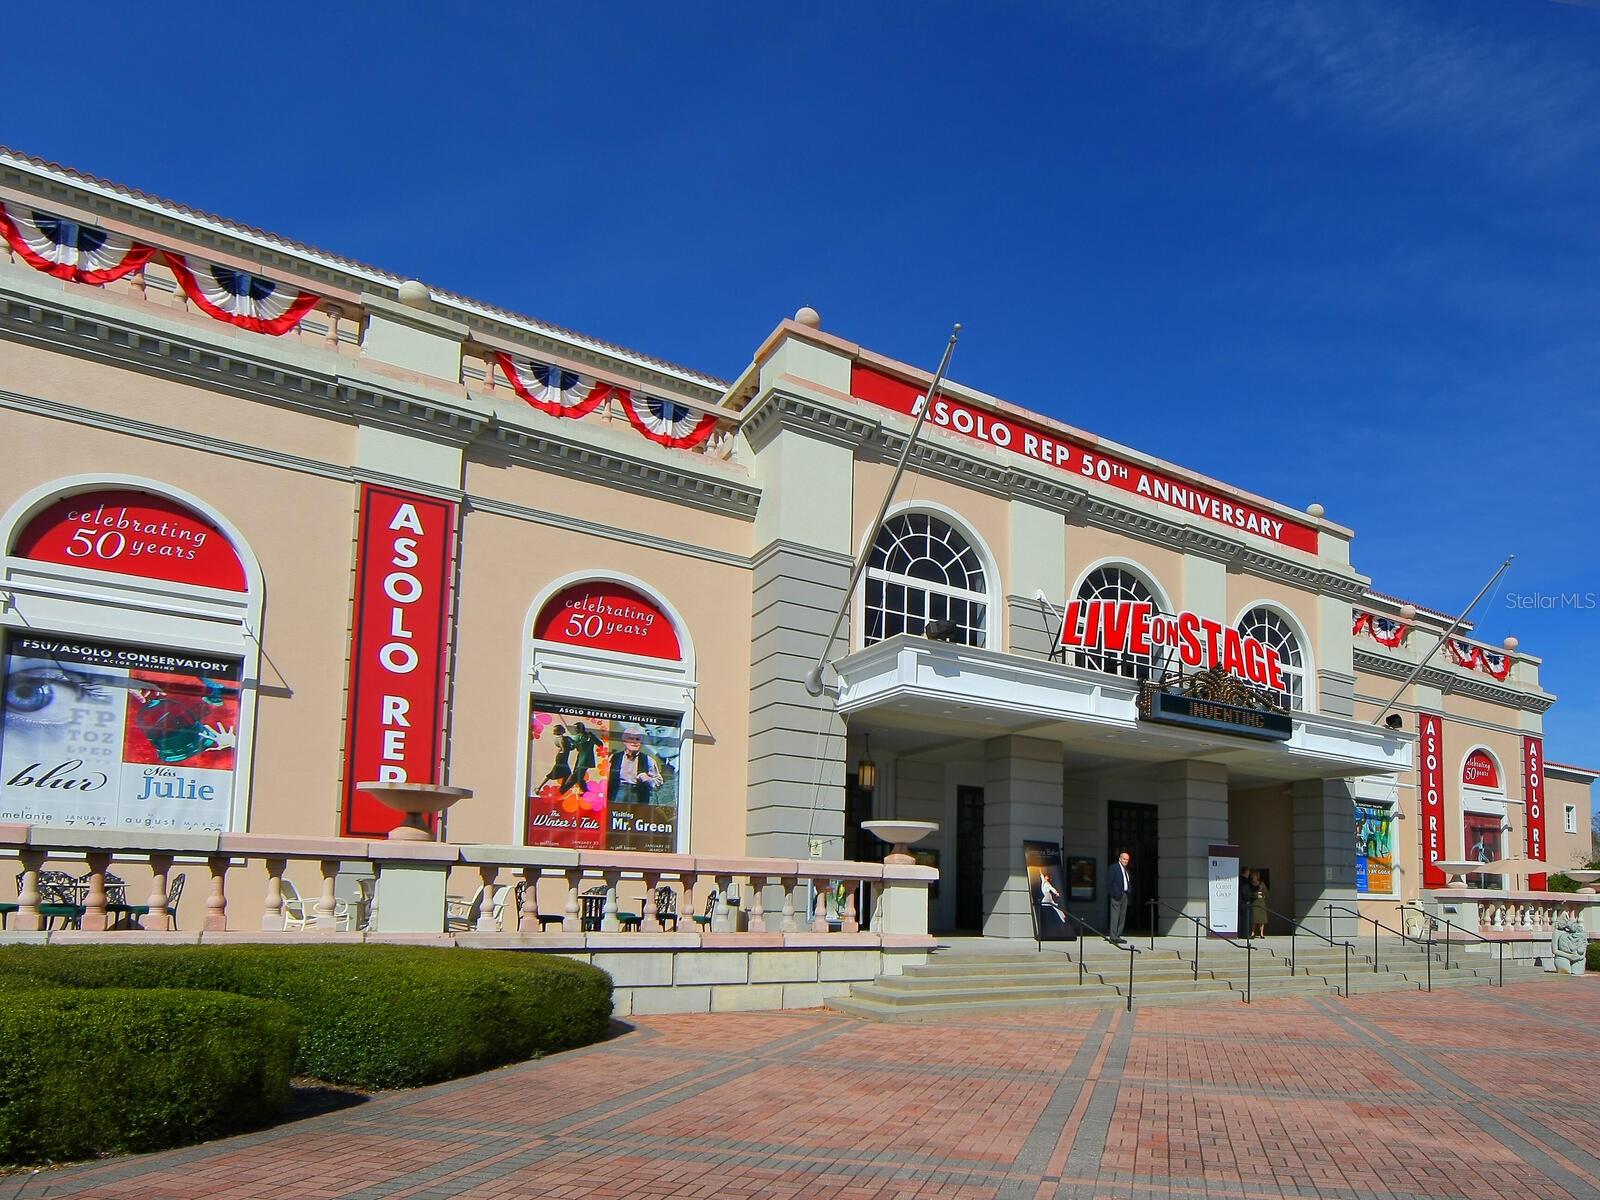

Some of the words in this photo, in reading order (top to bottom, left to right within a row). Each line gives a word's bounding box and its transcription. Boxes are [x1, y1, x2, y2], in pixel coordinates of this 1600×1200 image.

[910, 394, 1011, 446] ASOLO
[1024, 432, 1070, 465] REP
[1136, 474, 1284, 540] ANNIVERSARY
[67, 504, 207, 547] celebrating
[66, 528, 126, 560] 50
[129, 541, 196, 560] years
[378, 503, 424, 674] ASOLO
[565, 593, 655, 626] celebrating
[565, 613, 603, 638] 50
[605, 621, 648, 636] years
[22, 639, 112, 658] FSU/ASOLO
[117, 651, 229, 672] CONSERVATORY
[1060, 600, 1152, 656] LIVE
[1151, 617, 1179, 648] ON
[1177, 611, 1287, 692] STAGE
[135, 662, 175, 671] TRAINING
[559, 707, 584, 716] ASOLO
[586, 710, 626, 721] REPERTORY
[629, 715, 657, 724] THEATRE
[6, 759, 108, 792] blur
[143, 767, 176, 778] Miss
[1426, 720, 1438, 806] ASOLO
[1465, 767, 1477, 780] 50
[137, 776, 214, 801] Julie
[1529, 742, 1540, 819] ASOLO
[2, 811, 53, 821] melanie
[125, 817, 175, 827] august
[533, 815, 577, 828] Winter's
[579, 817, 600, 829] Tale
[612, 811, 634, 819] Visiting
[612, 818, 632, 831] Mr.
[635, 819, 672, 833] Green
